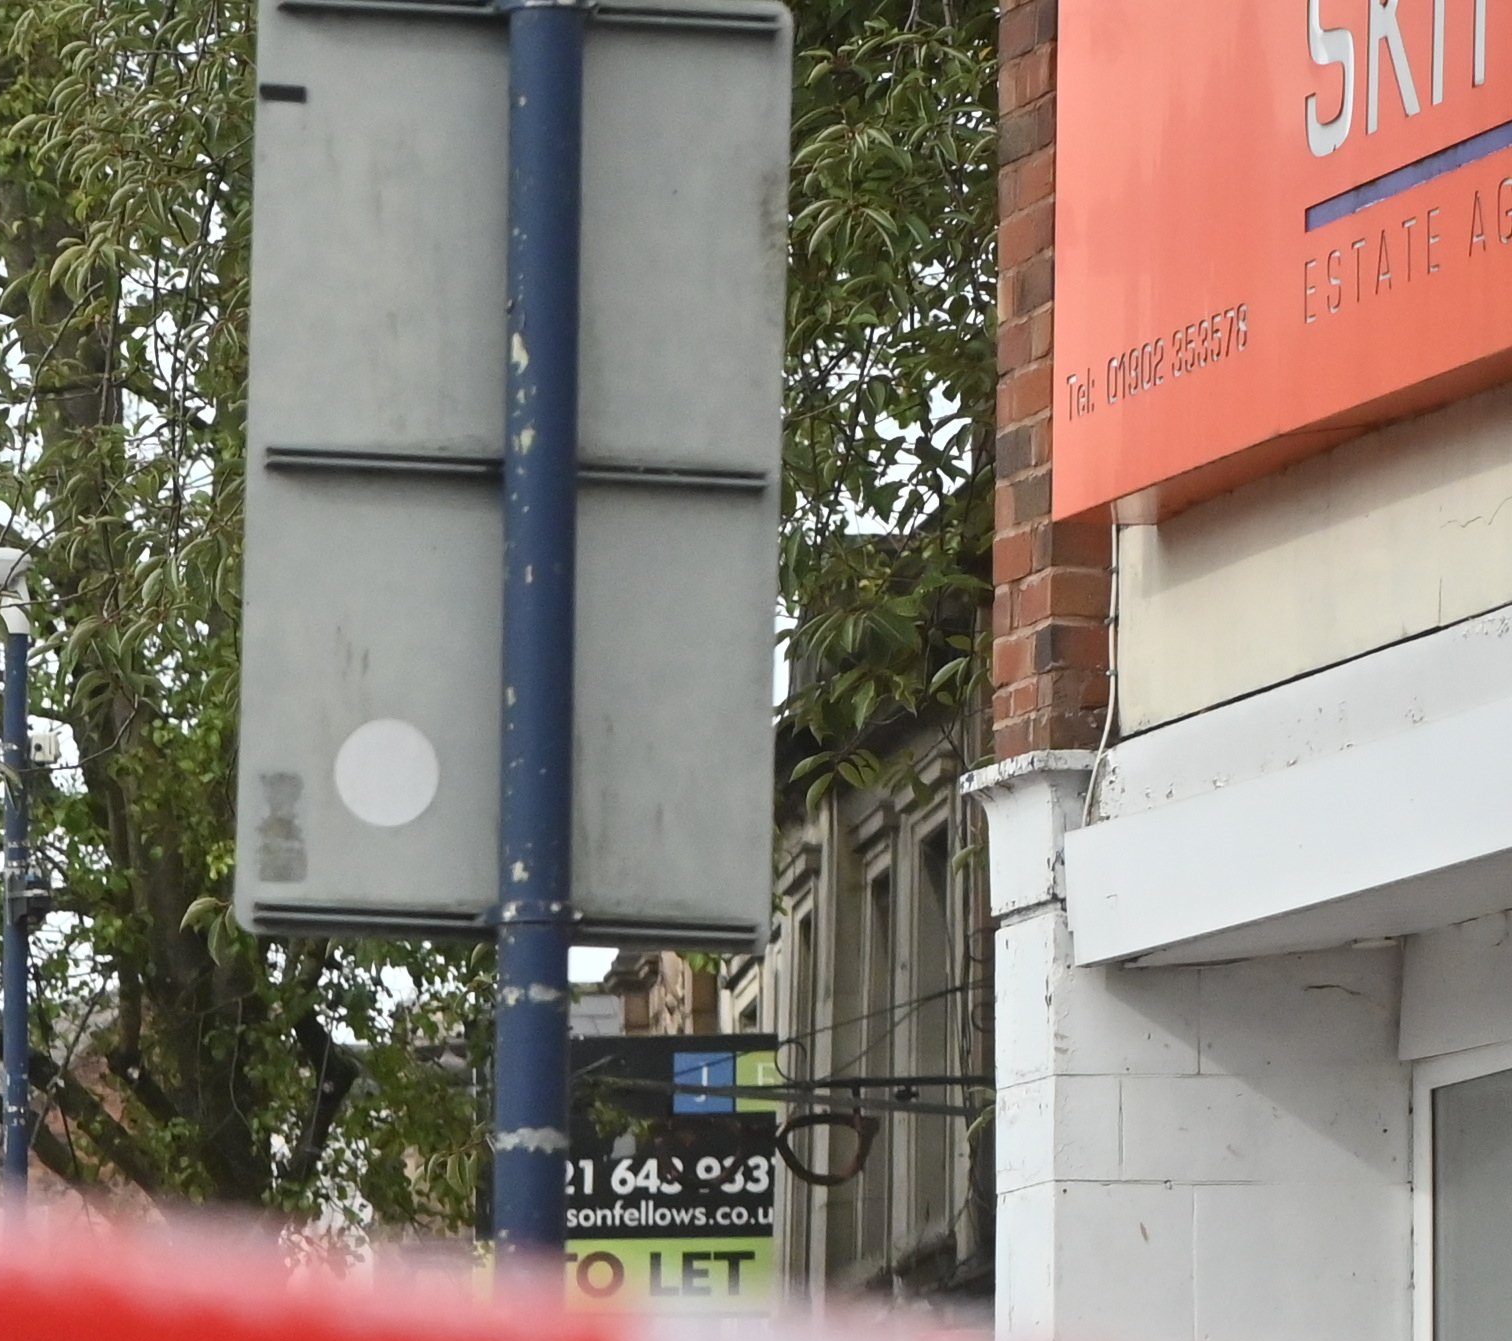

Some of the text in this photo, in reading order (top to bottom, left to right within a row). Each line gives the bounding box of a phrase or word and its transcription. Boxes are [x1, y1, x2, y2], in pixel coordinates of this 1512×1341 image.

[1304, 207, 1440, 324] ESTATE
[1067, 367, 1095, 421] Tel:
[1172, 302, 1248, 377] 353578
[650, 1250, 756, 1297] LET
